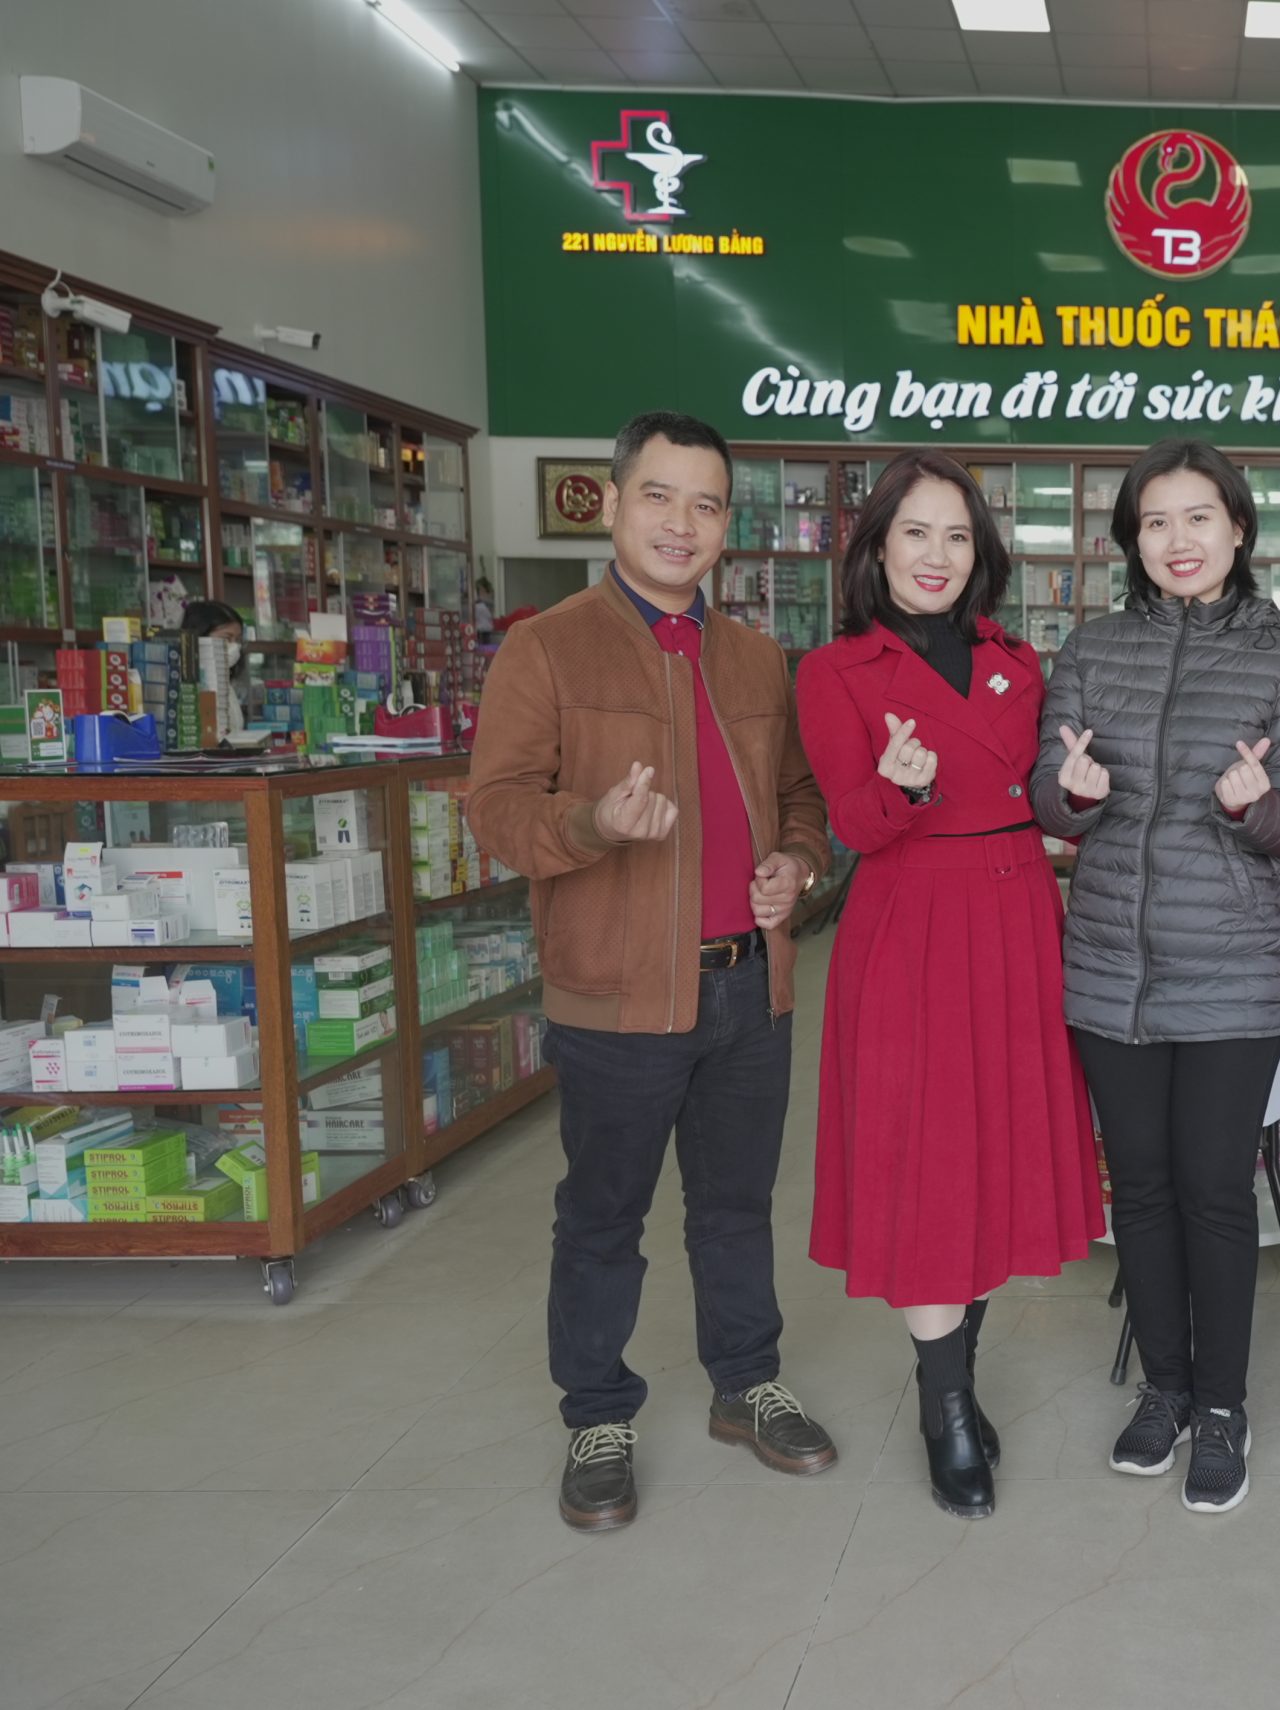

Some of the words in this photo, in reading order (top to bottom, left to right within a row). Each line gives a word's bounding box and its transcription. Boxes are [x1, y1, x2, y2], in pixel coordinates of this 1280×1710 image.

[562, 232, 590, 251] 221
[1152, 228, 1201, 265] TB
[956, 296, 1044, 346] NHÀ
[1055, 293, 1192, 348] THUỐC
[742, 364, 881, 432] Cùng
[889, 370, 992, 429] bạn
[1000, 370, 1059, 419] đi
[1065, 371, 1138, 420] tới
[1143, 369, 1233, 421] sức
[325, 1119, 365, 1129] HAIRCARE
[90, 1153, 127, 1161] STIPROL
[91, 1170, 129, 1178] STIPROL
[92, 1186, 129, 1194] STIPROL
